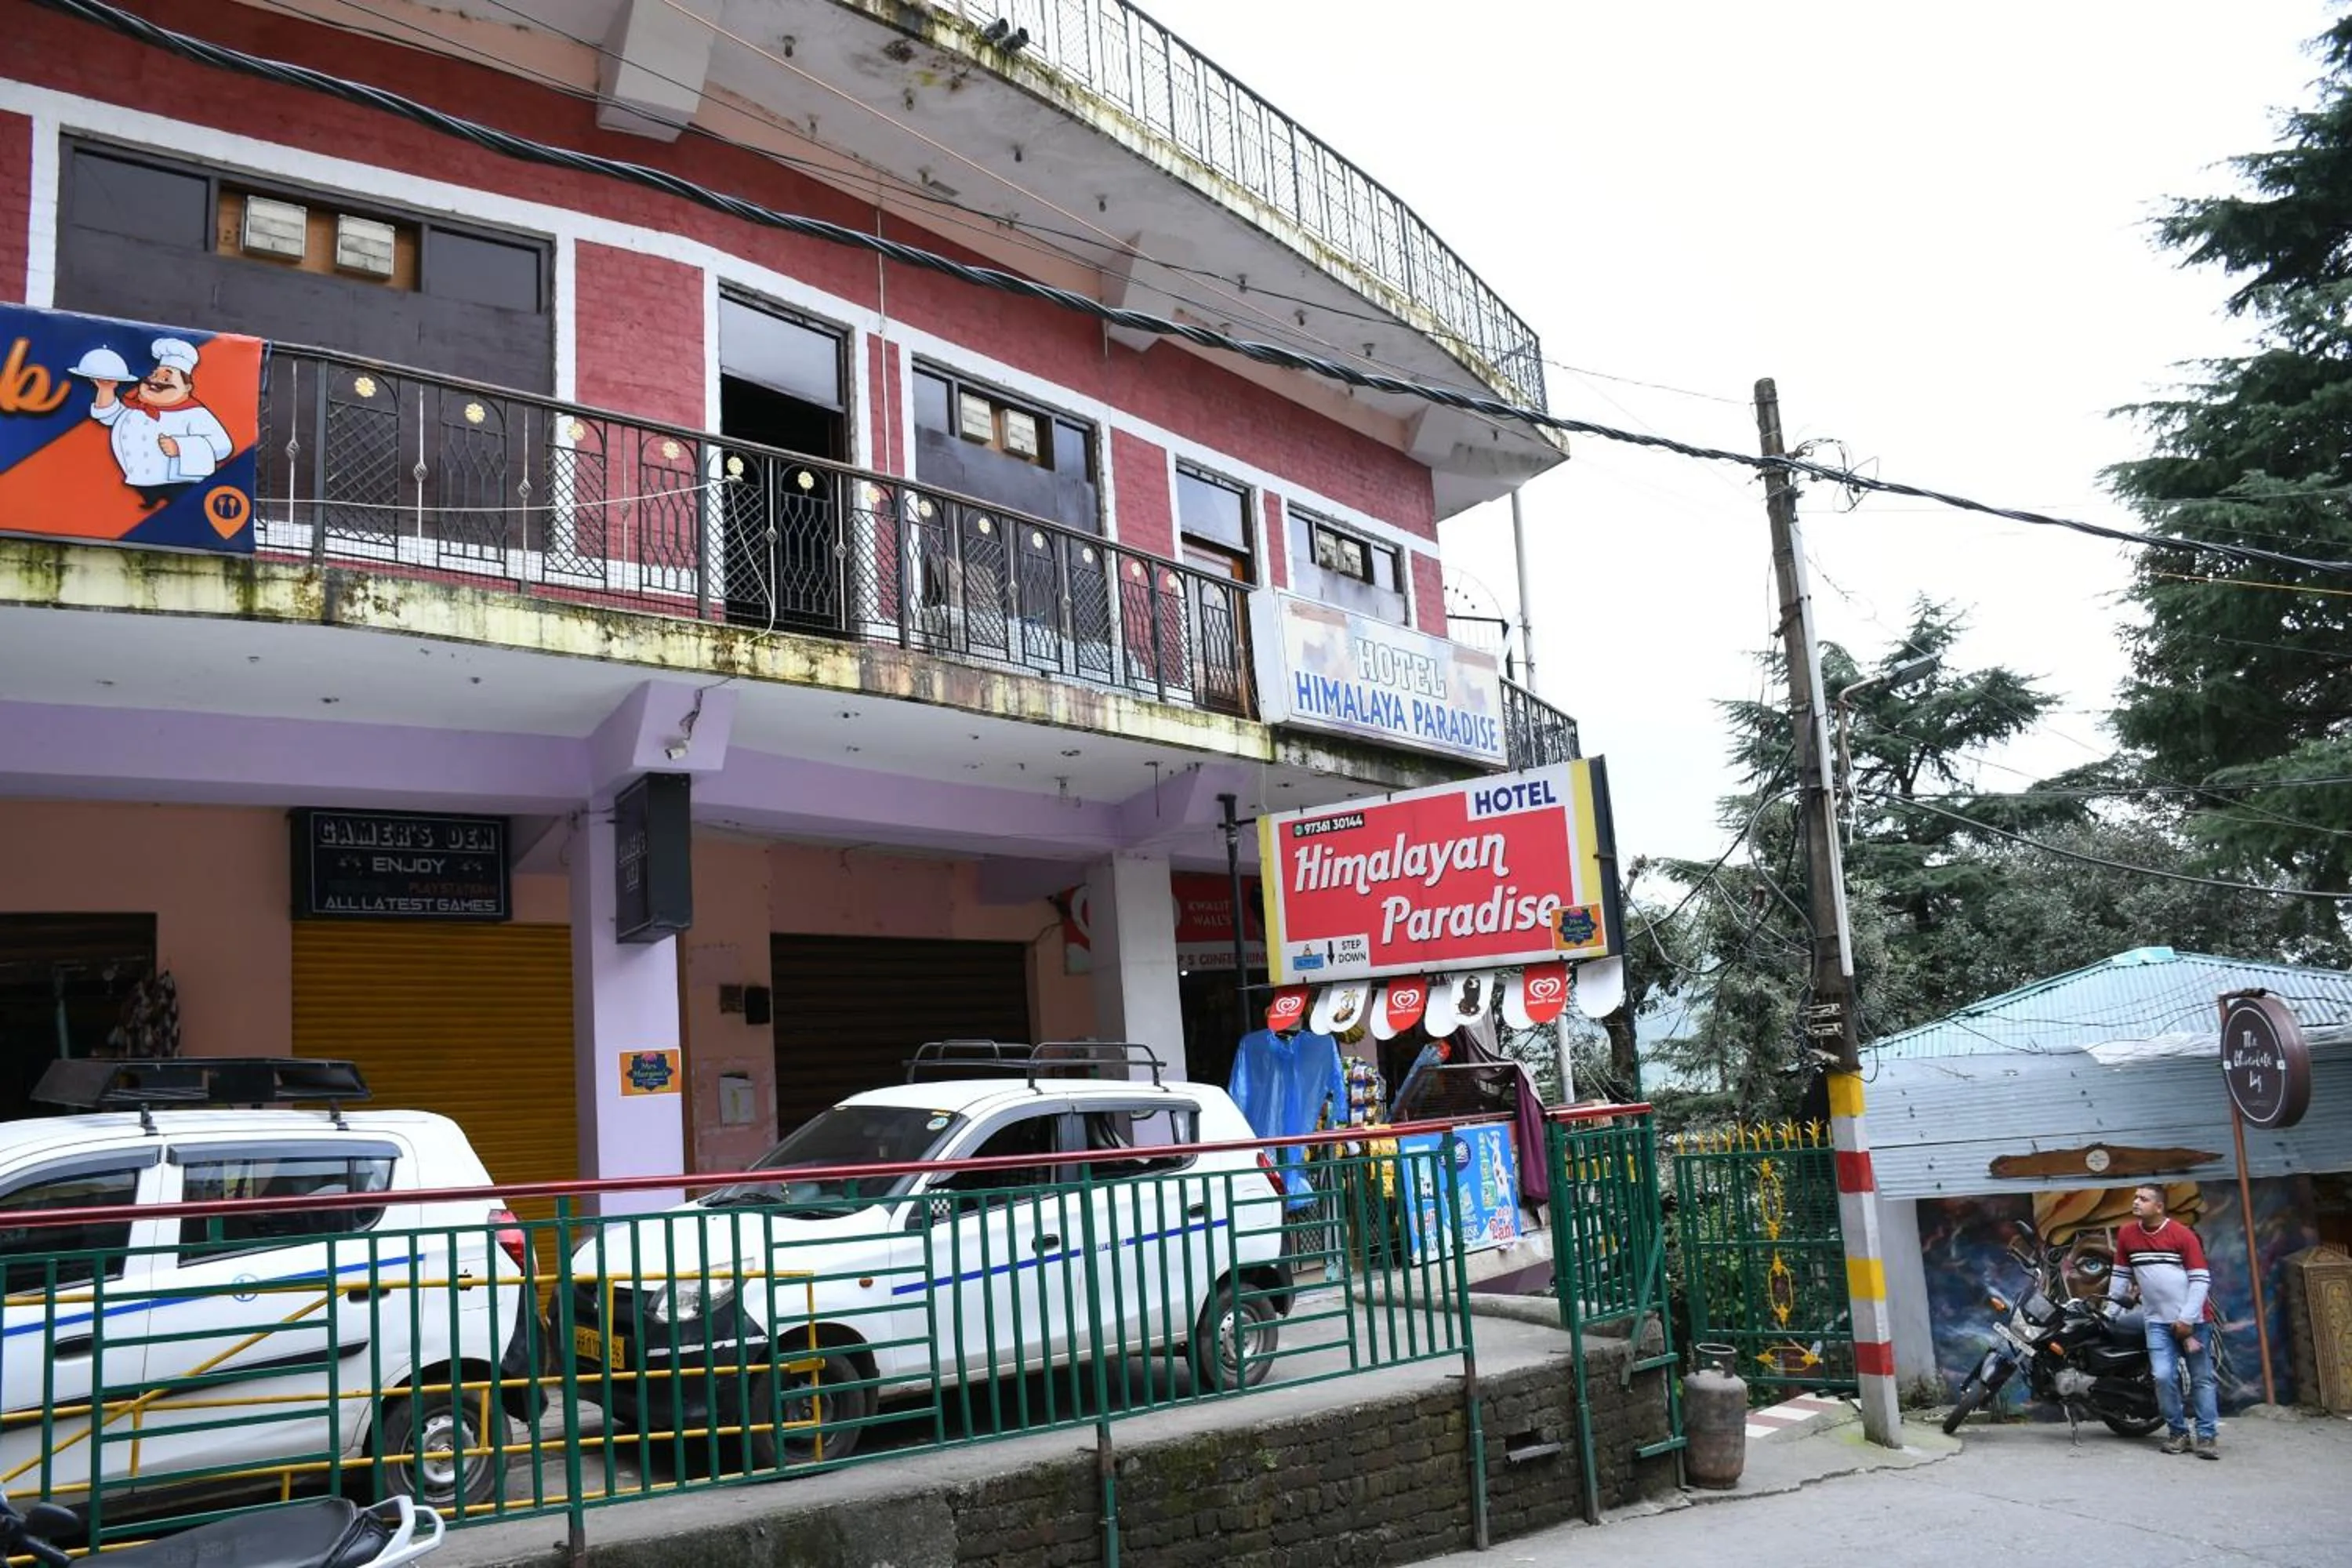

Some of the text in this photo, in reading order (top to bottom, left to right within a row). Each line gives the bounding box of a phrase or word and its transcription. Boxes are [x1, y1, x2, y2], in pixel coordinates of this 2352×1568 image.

[1354, 637, 1447, 699] HOTEL
[1295, 670, 1498, 752] HIMALAYA PARADISE
[1475, 780, 1556, 815] HOTEL
[319, 819, 496, 851] GAMER'S DEN
[1304, 815, 1363, 835] 97361 30144
[372, 856, 445, 874] ENJOY
[1294, 833, 1510, 895] Himalayan
[325, 896, 496, 912] ALL LATEST GAMES
[1187, 902, 1230, 912] KWALIT
[1381, 885, 1562, 945] Paradise
[1341, 939, 1361, 950] STEP
[1338, 952, 1367, 964] DOWN
